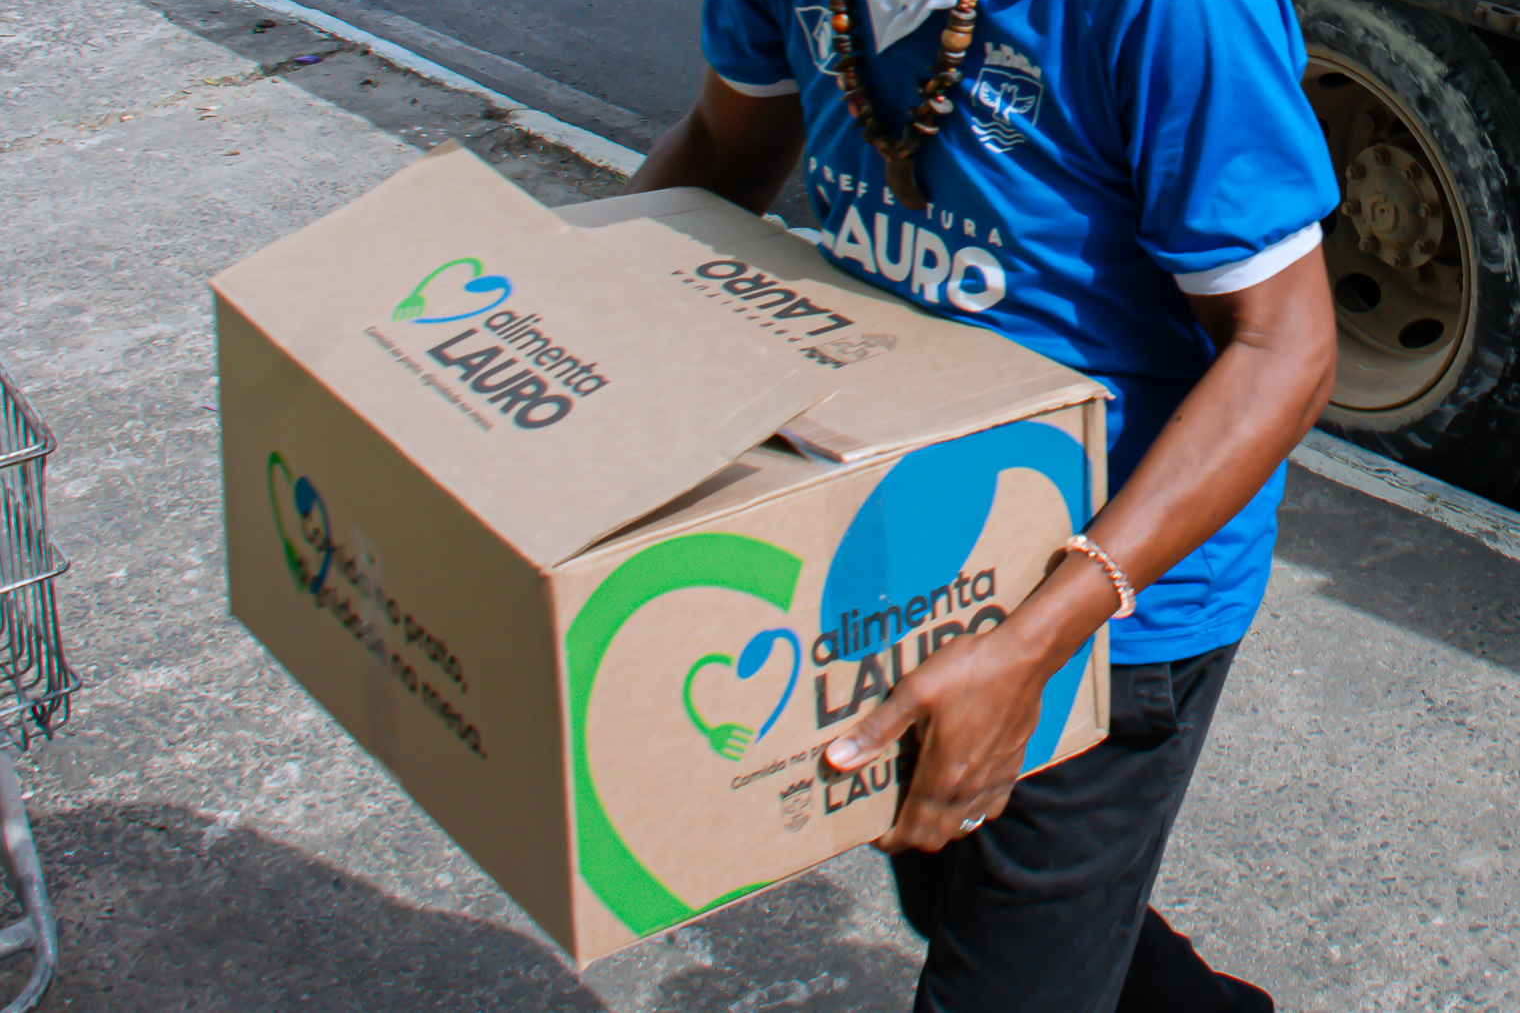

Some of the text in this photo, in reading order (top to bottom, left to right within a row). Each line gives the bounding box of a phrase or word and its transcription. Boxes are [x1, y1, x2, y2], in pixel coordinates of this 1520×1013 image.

[808, 156, 1003, 246] PREFETURA
[695, 260, 856, 336] LAURO
[427, 329, 574, 430] LAURO
[482, 309, 610, 399] alimenta
[811, 567, 996, 668] alimenta
[731, 751, 807, 790] Comida no
